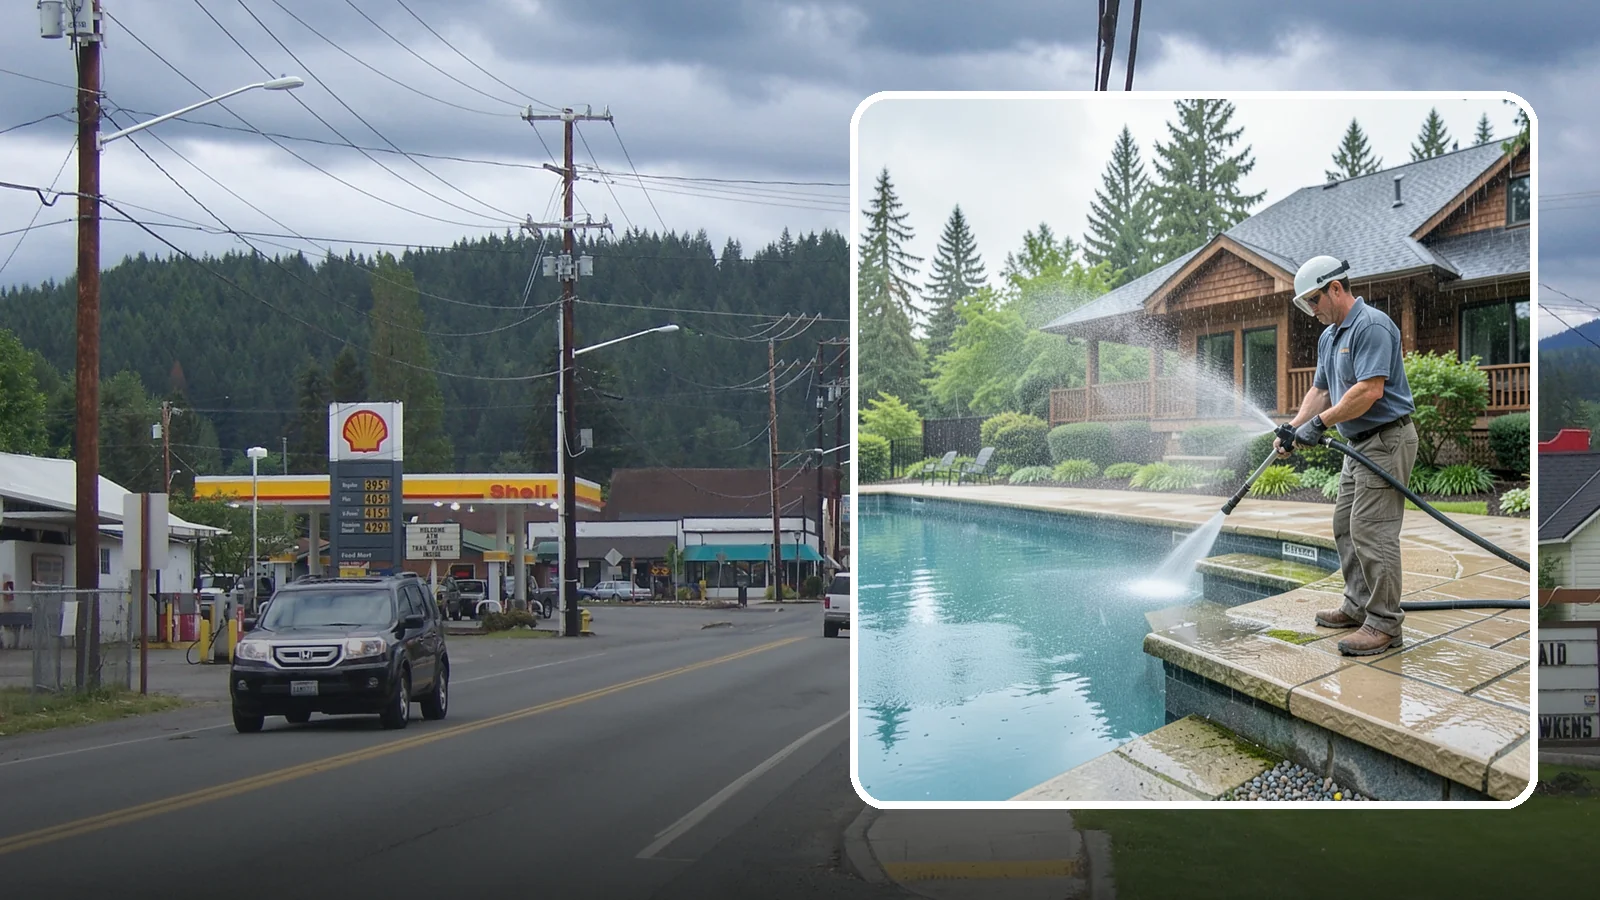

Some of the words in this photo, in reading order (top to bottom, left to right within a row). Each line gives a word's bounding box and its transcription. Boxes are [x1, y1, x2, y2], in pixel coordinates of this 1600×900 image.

[366, 480, 384, 490] 395
[490, 484, 547, 499] Shell
[366, 494, 384, 504] 405
[366, 508, 384, 518] 415
[366, 522, 384, 532] 429
